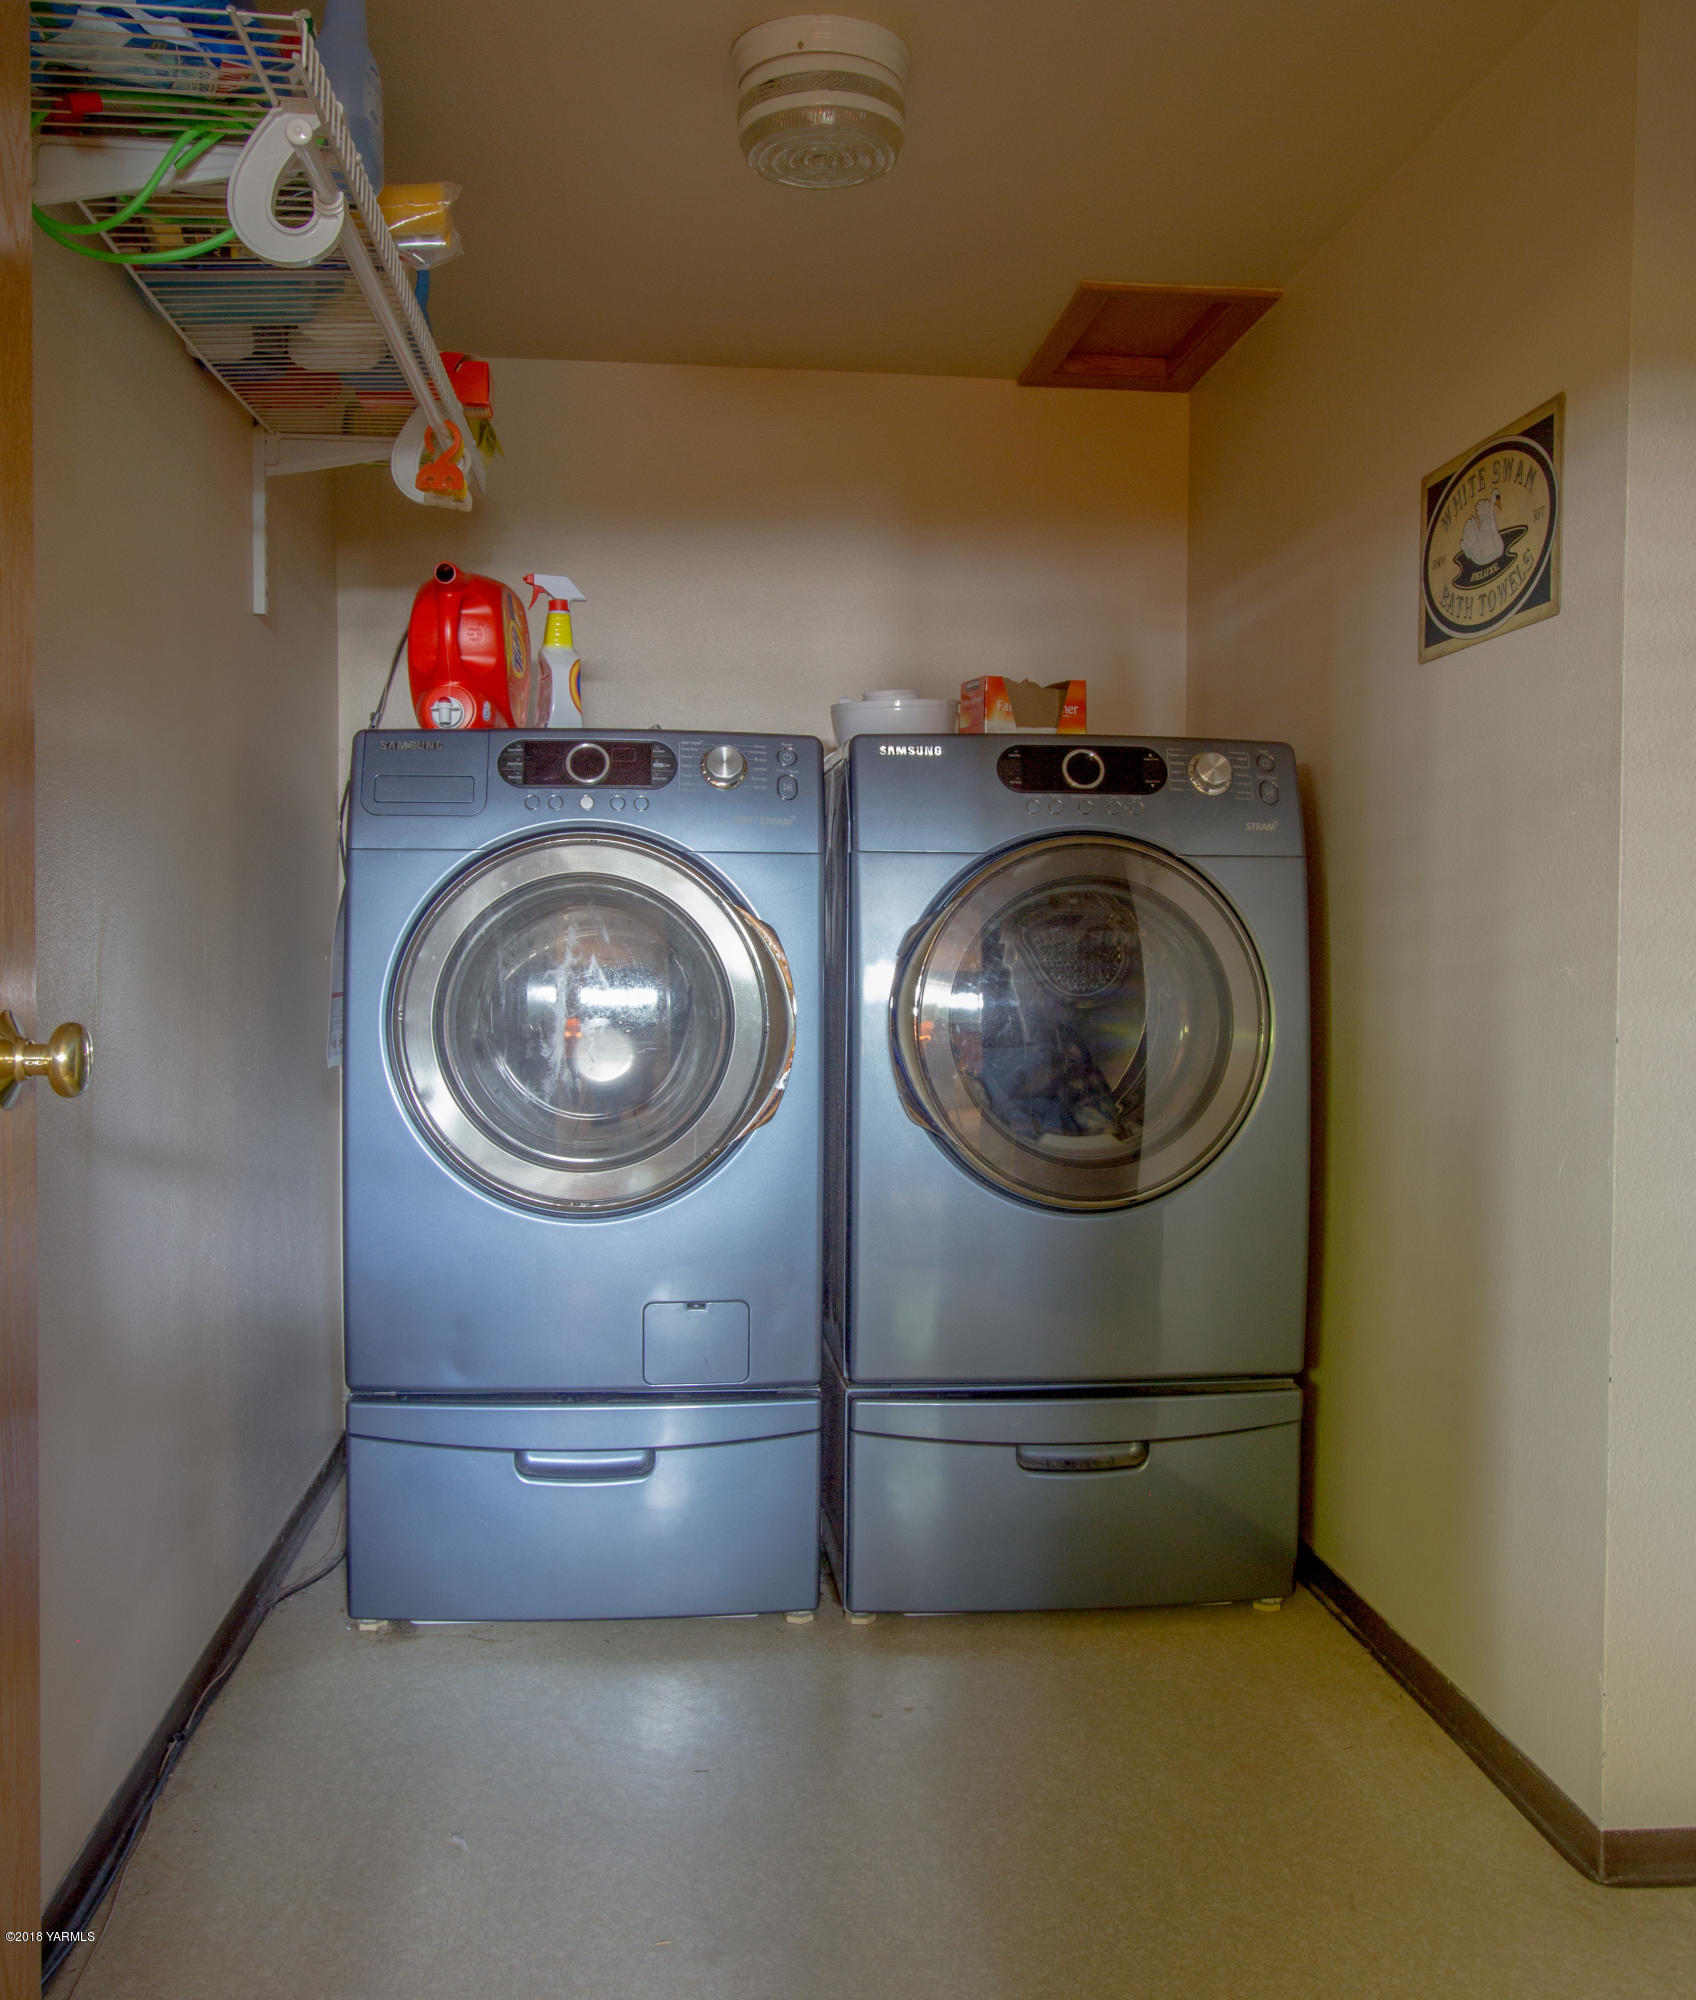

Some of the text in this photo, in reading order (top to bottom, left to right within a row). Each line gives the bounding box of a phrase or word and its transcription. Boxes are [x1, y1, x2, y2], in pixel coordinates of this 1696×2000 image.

[1441, 457, 1538, 533] WHITE SWAN
[1469, 561, 1501, 583] DELUXE
[1439, 547, 1536, 621] BATH TOWELS
[379, 740, 444, 752] SAMSUNG
[878, 744, 943, 757] SAMSUNG
[1244, 821, 1278, 833] STEAM
